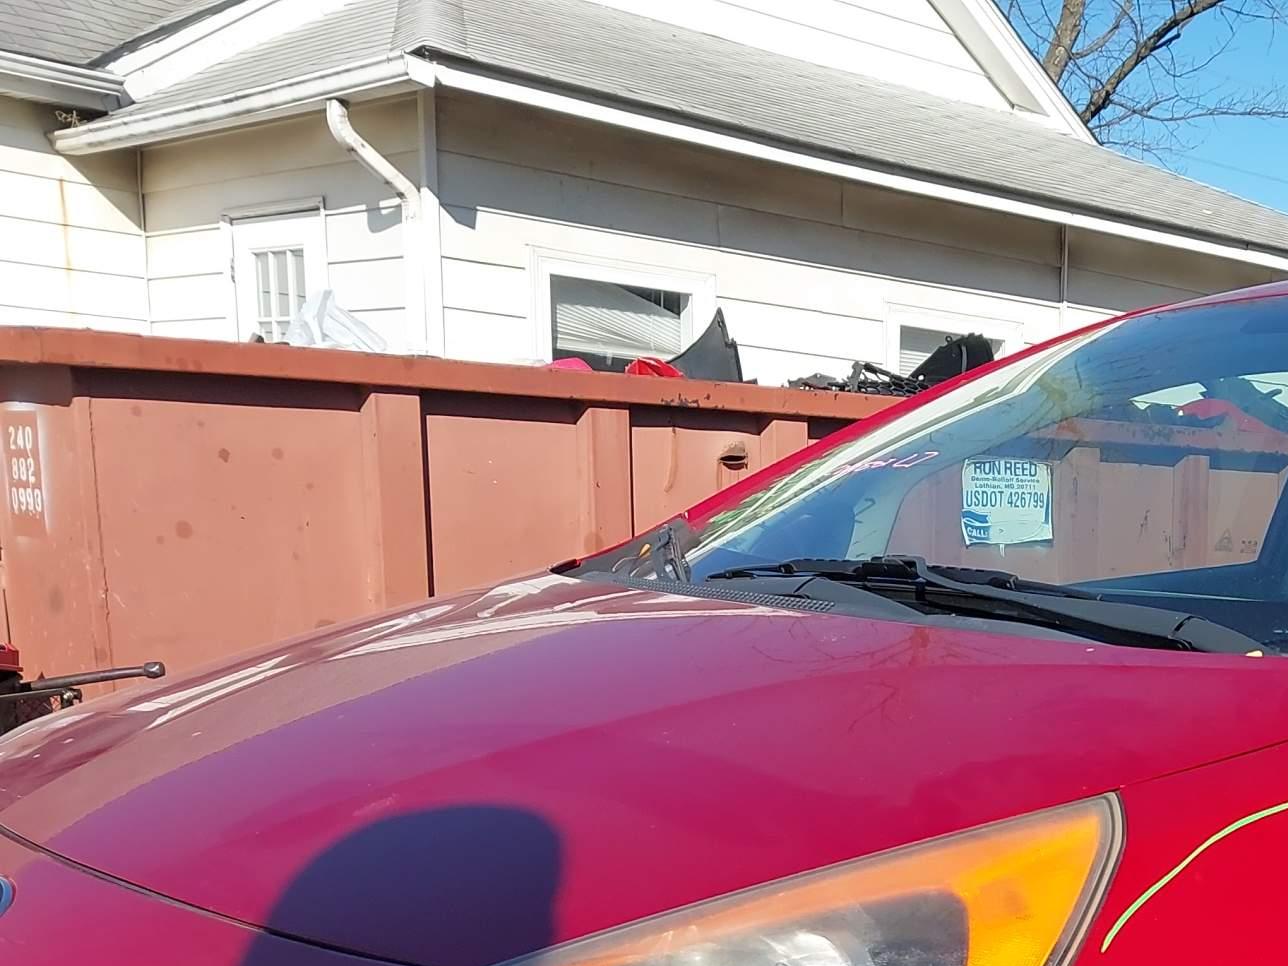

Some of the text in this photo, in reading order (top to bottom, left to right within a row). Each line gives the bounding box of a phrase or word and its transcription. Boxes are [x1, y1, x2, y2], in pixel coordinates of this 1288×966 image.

[8, 425, 33, 450] 240
[11, 457, 36, 483] 882
[1004, 461, 1037, 477] REED
[966, 490, 1045, 508] USDOT 426799
